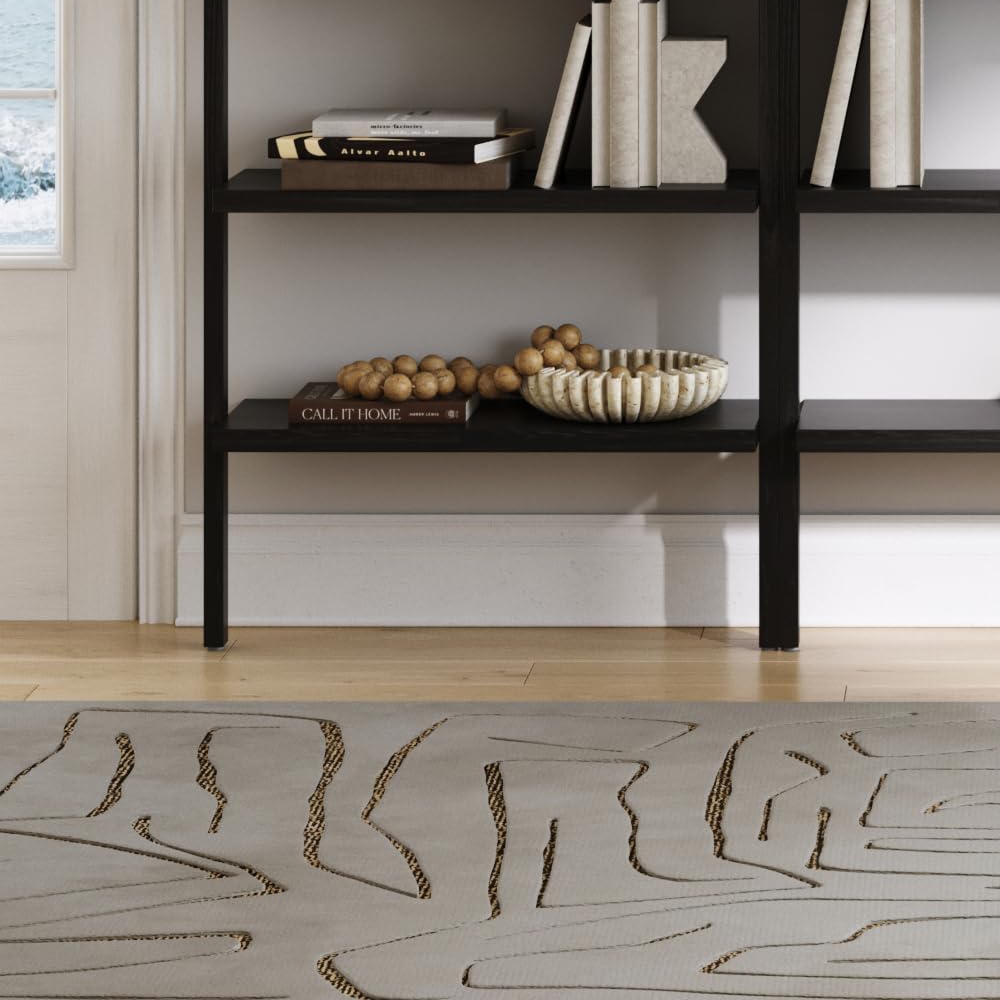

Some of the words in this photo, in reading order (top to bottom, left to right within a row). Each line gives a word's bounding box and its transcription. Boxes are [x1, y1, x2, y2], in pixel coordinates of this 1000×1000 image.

[341, 147, 380, 156] Alvar
[387, 149, 426, 157] Aalto
[301, 408, 339, 421] CALL
[341, 408, 356, 421] IT
[358, 408, 402, 421] HOME
